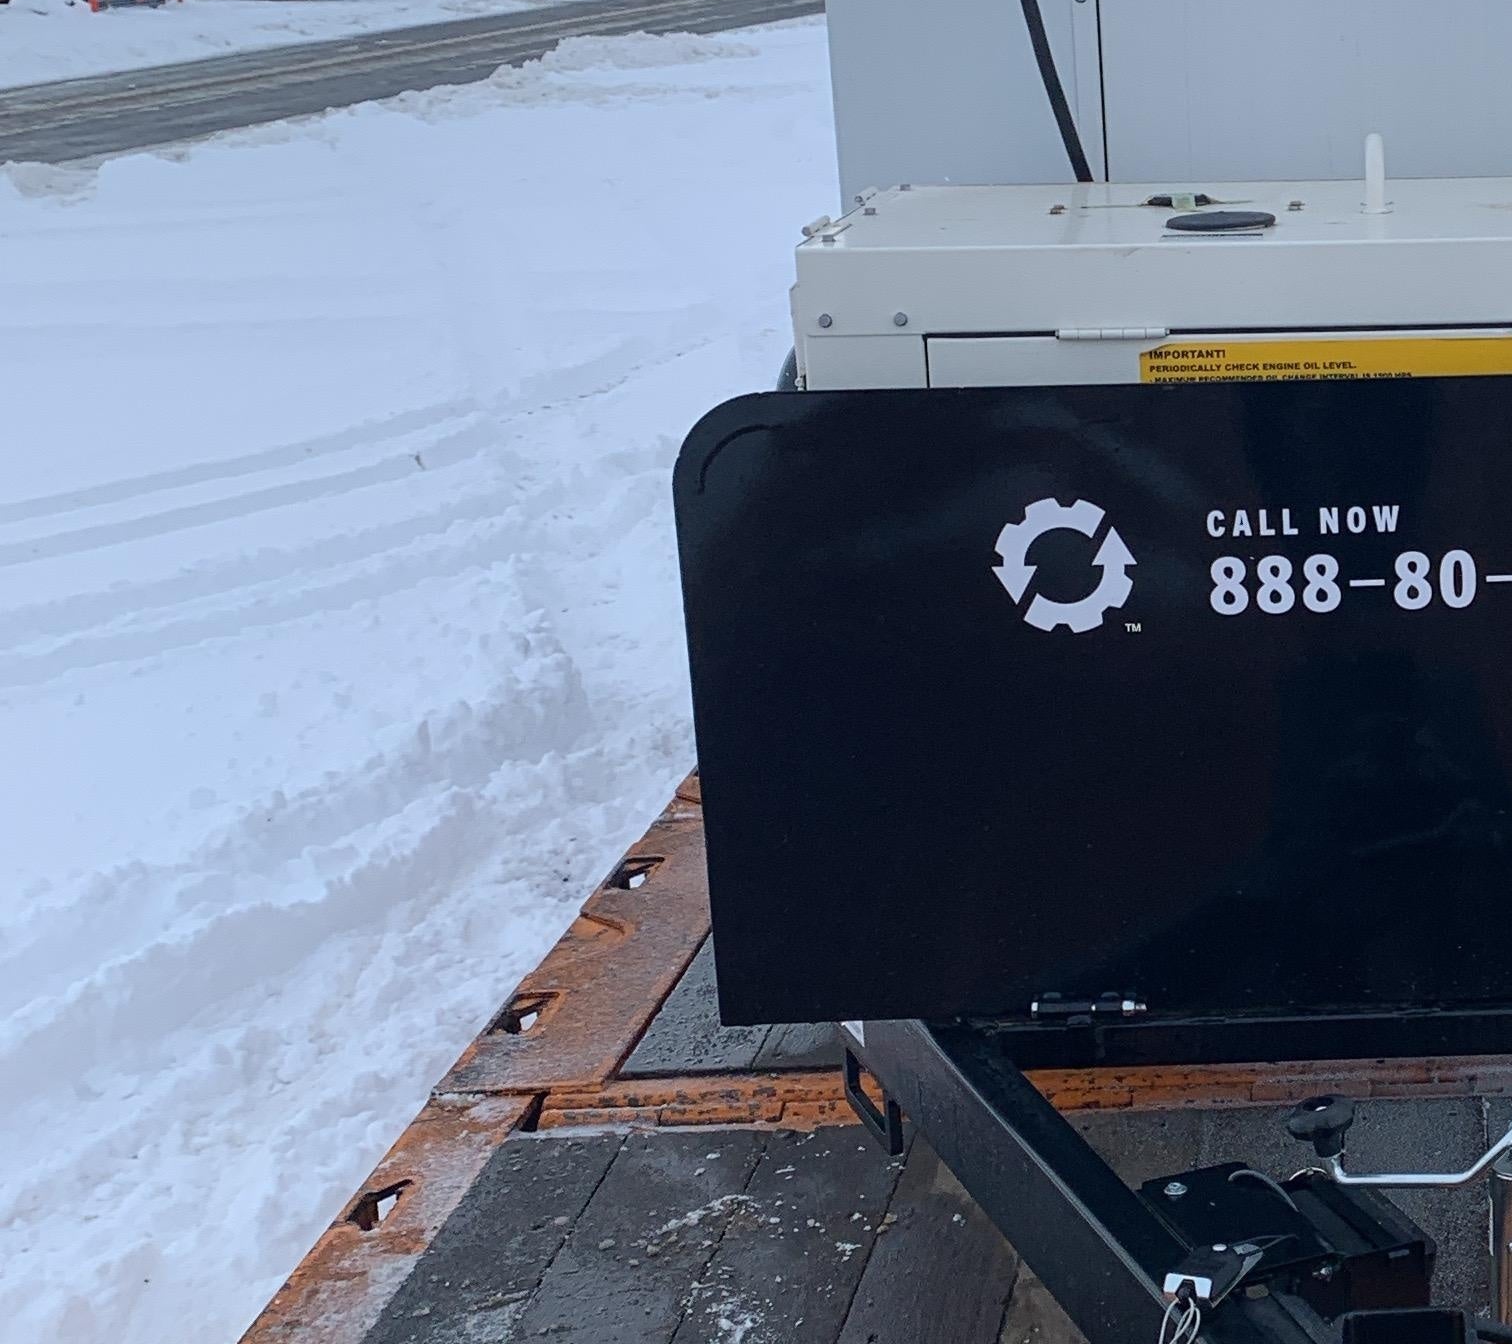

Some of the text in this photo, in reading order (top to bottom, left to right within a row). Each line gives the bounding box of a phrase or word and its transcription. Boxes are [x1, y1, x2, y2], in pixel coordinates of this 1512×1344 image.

[1149, 349, 1226, 360] IMPORTANT!
[1149, 361, 1357, 373] PERIODICALLY CHECK ENGINE OIL LEVEL.
[1205, 505, 1401, 538] CALL NOW
